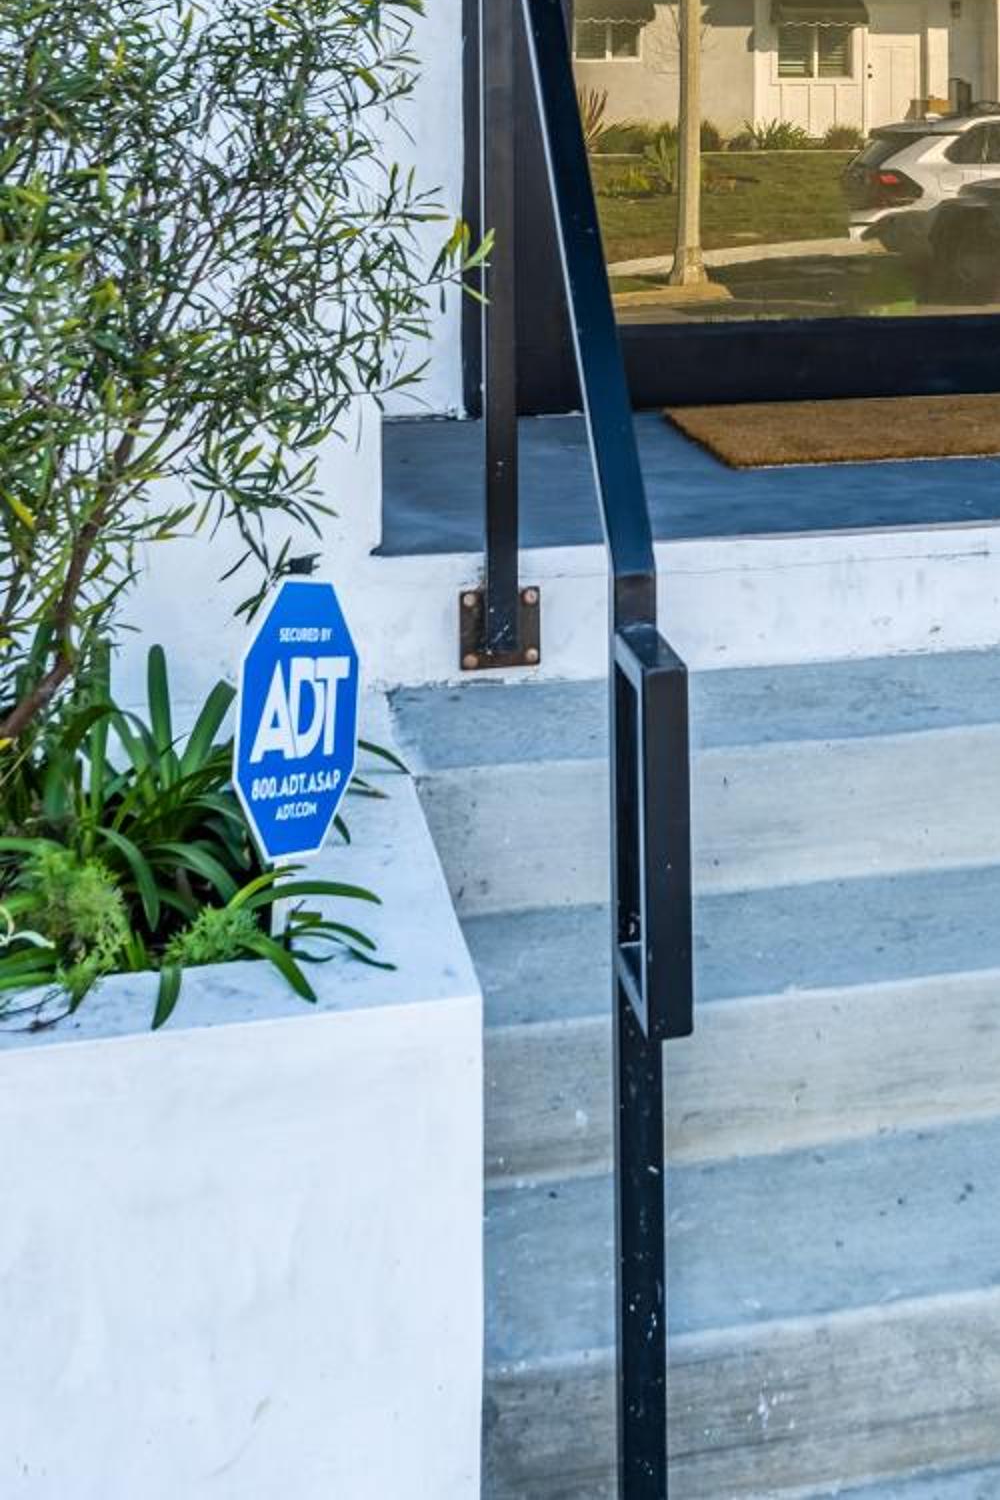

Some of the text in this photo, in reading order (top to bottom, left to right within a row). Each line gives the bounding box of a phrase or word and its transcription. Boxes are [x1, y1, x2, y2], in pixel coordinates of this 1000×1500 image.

[279, 627, 332, 643] SECURED BY
[250, 656, 350, 763] ADT
[251, 769, 341, 801] 800.ADT.ASAP
[275, 801, 317, 821] ADT.COM
